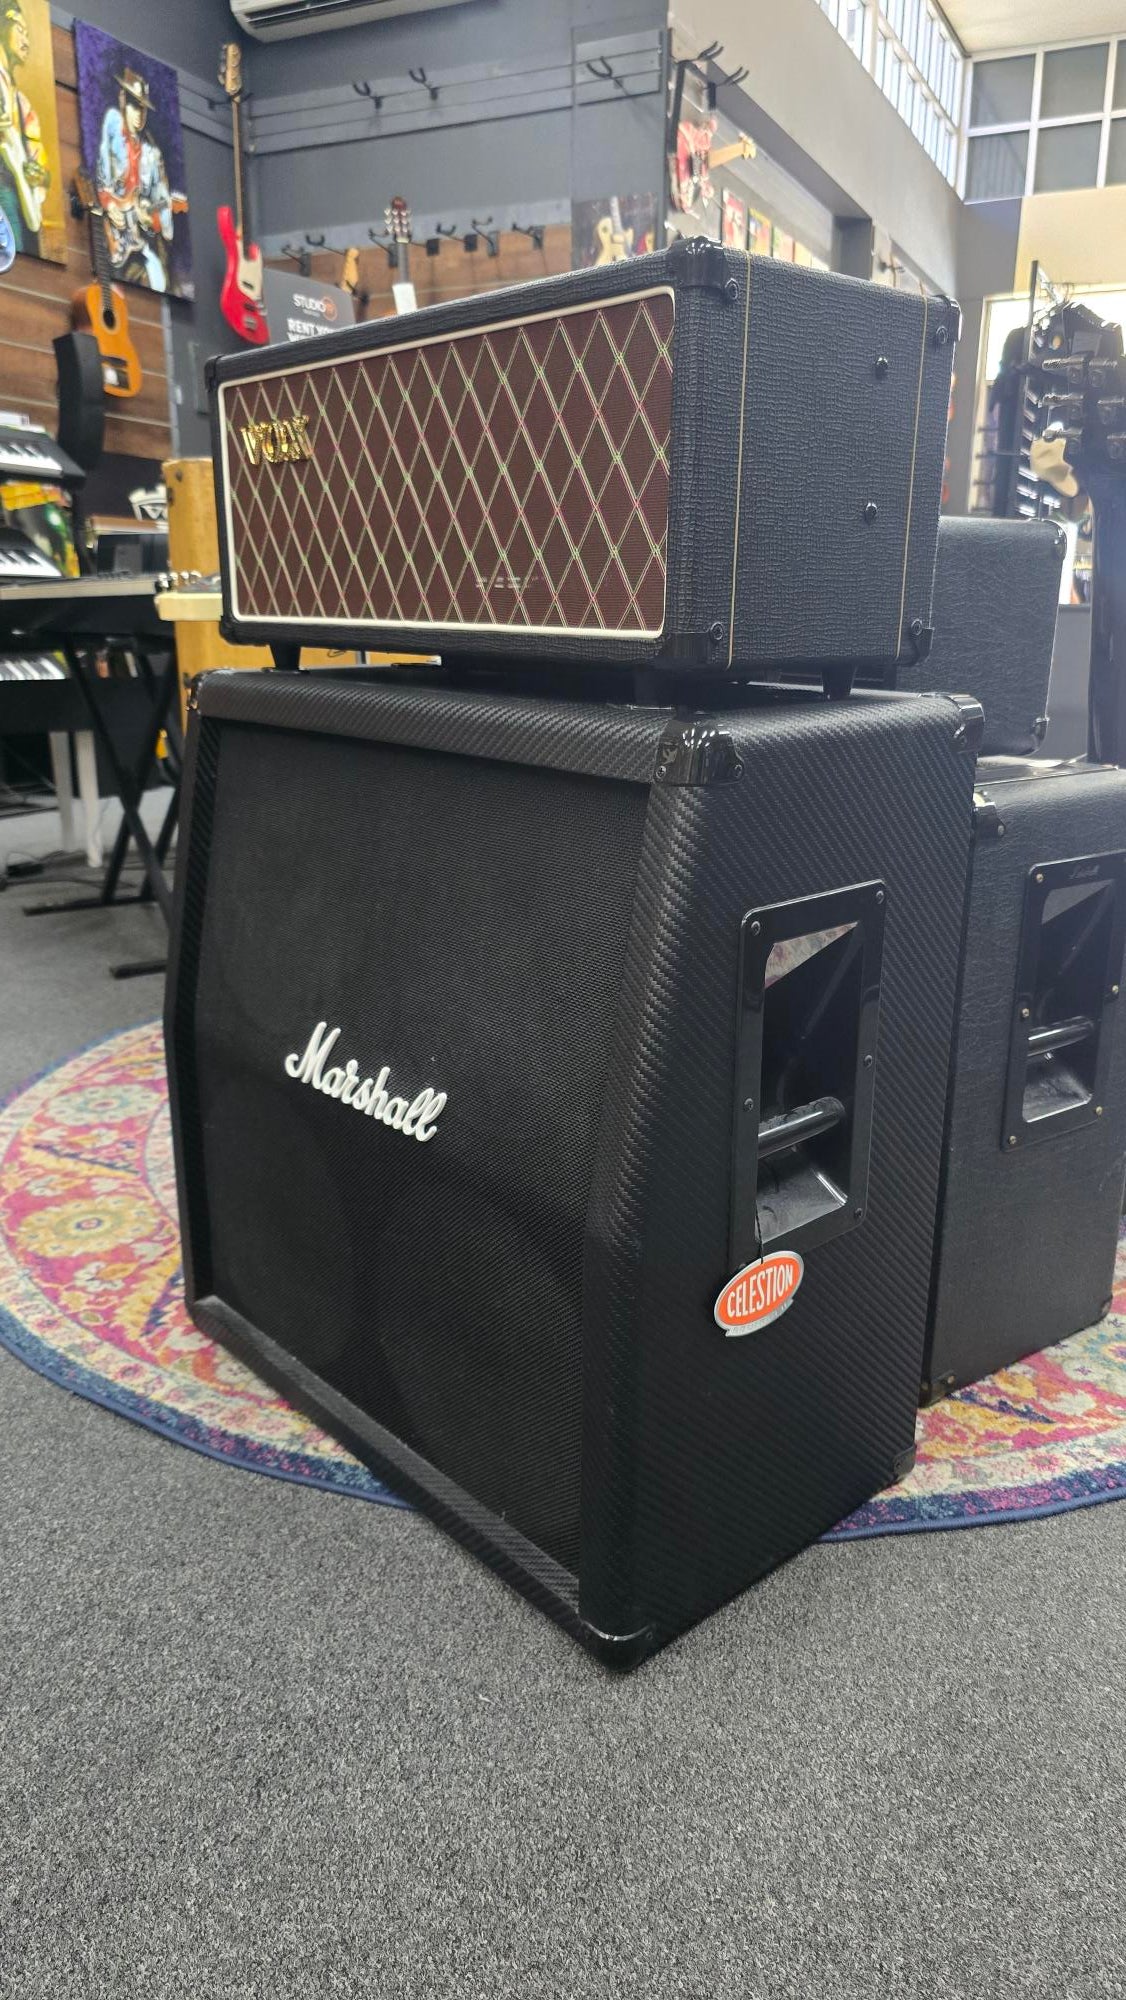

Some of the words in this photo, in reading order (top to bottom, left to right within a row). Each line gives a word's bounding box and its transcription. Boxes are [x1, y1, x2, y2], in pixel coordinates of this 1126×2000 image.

[287, 318, 314, 336] RENT
[293, 293, 326, 312] STUDIO
[240, 415, 311, 465] VOX
[284, 1021, 448, 1142] Marshall
[726, 1264, 794, 1318] CELESTION
